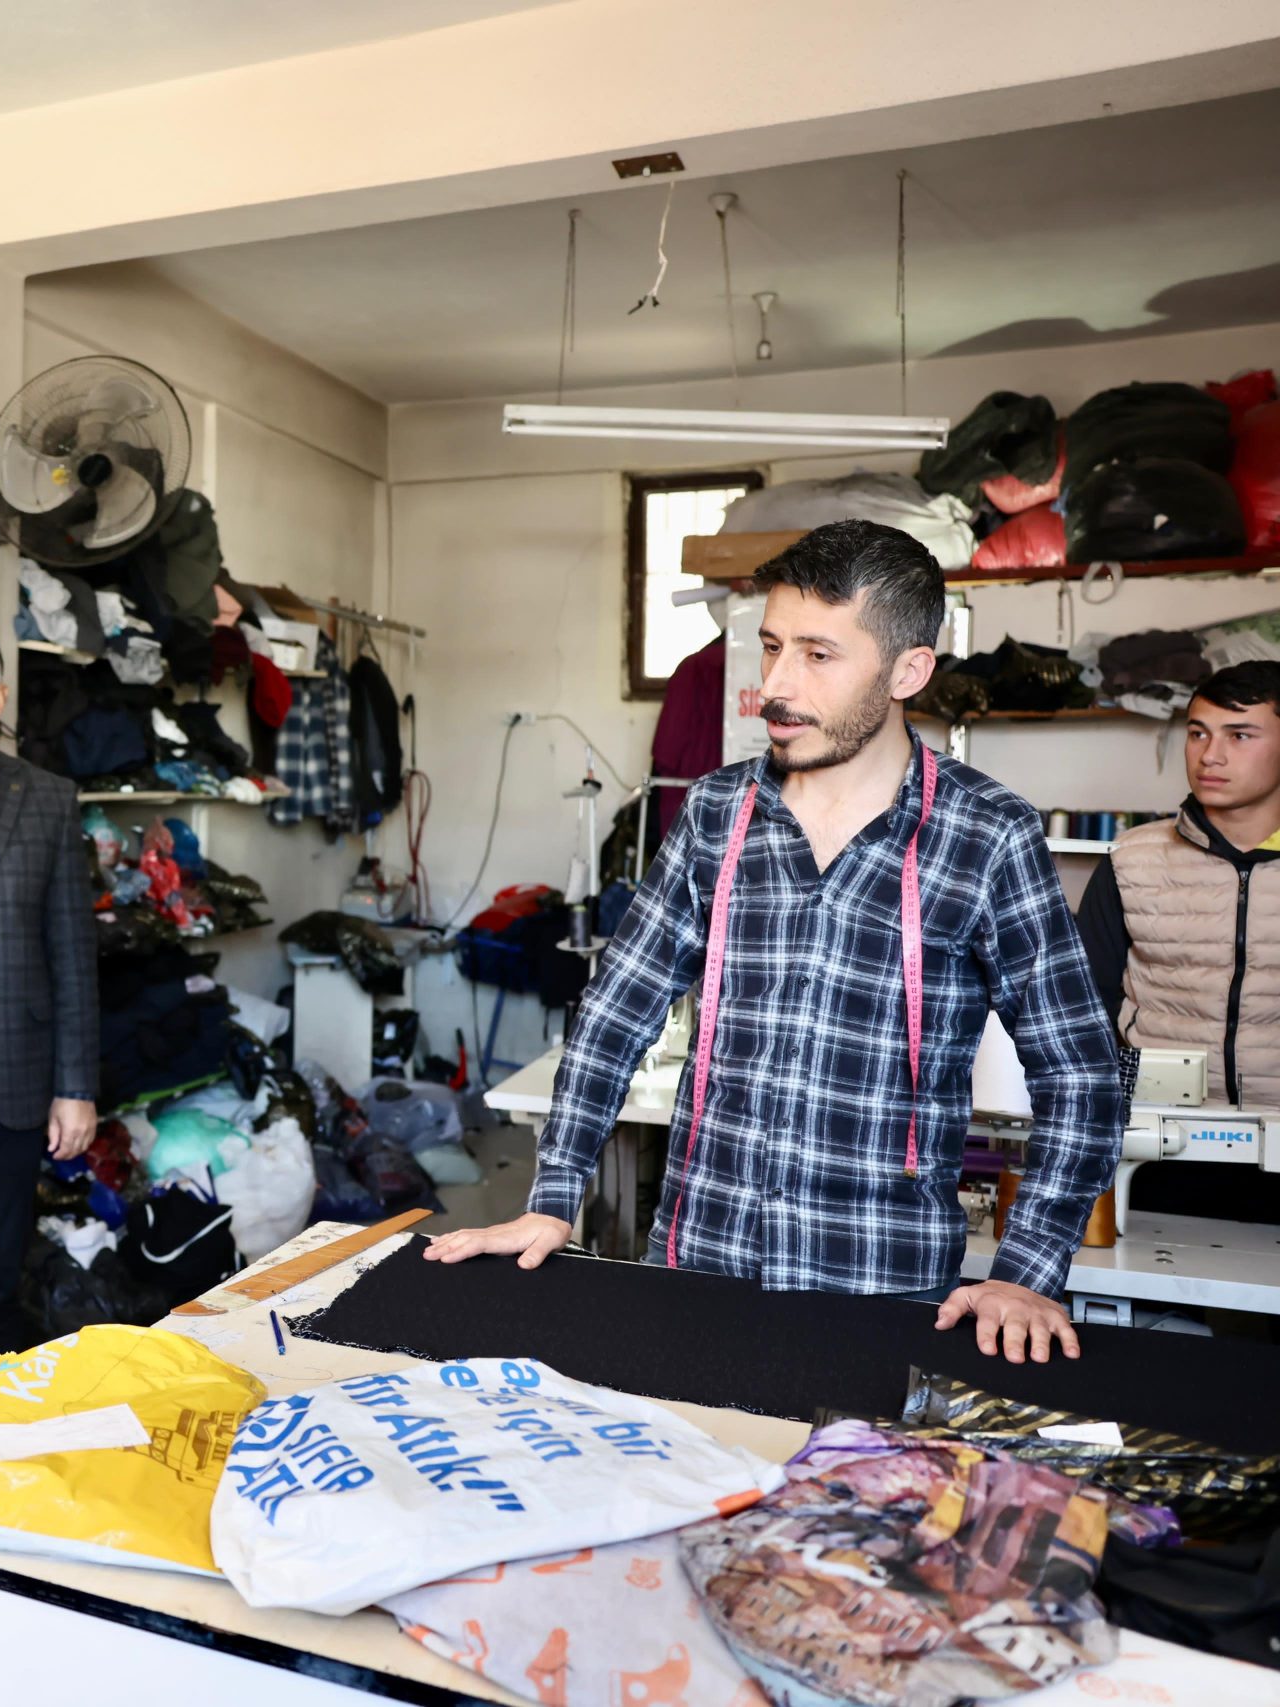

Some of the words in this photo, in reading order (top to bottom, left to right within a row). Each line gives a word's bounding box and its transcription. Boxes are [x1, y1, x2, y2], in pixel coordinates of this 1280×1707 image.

[1191, 1131, 1253, 1143] JUKI
[283, 1424, 375, 1492] SIFIR
[494, 1408, 582, 1462] için
[592, 1422, 672, 1461] bir
